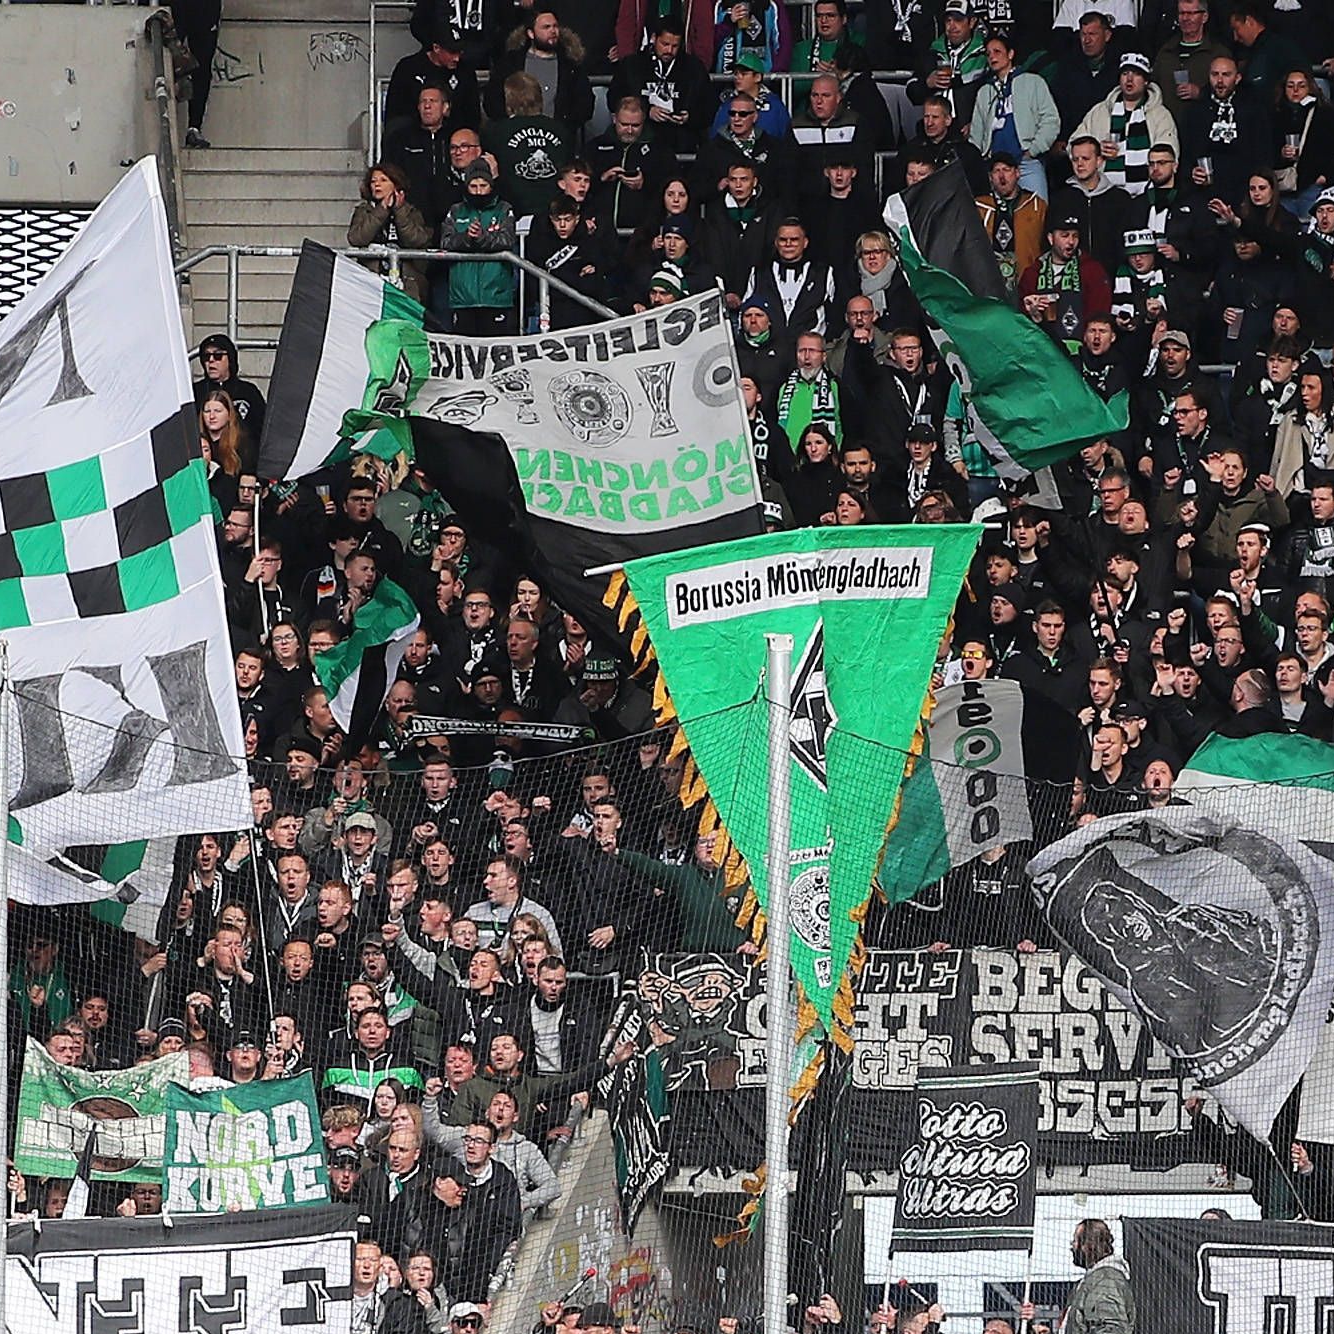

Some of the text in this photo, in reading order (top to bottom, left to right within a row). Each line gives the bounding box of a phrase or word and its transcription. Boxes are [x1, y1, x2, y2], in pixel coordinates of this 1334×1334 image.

[675, 573, 761, 616] Borussia
[172, 1098, 318, 1168] NORD
[169, 1150, 327, 1212] KURVE
